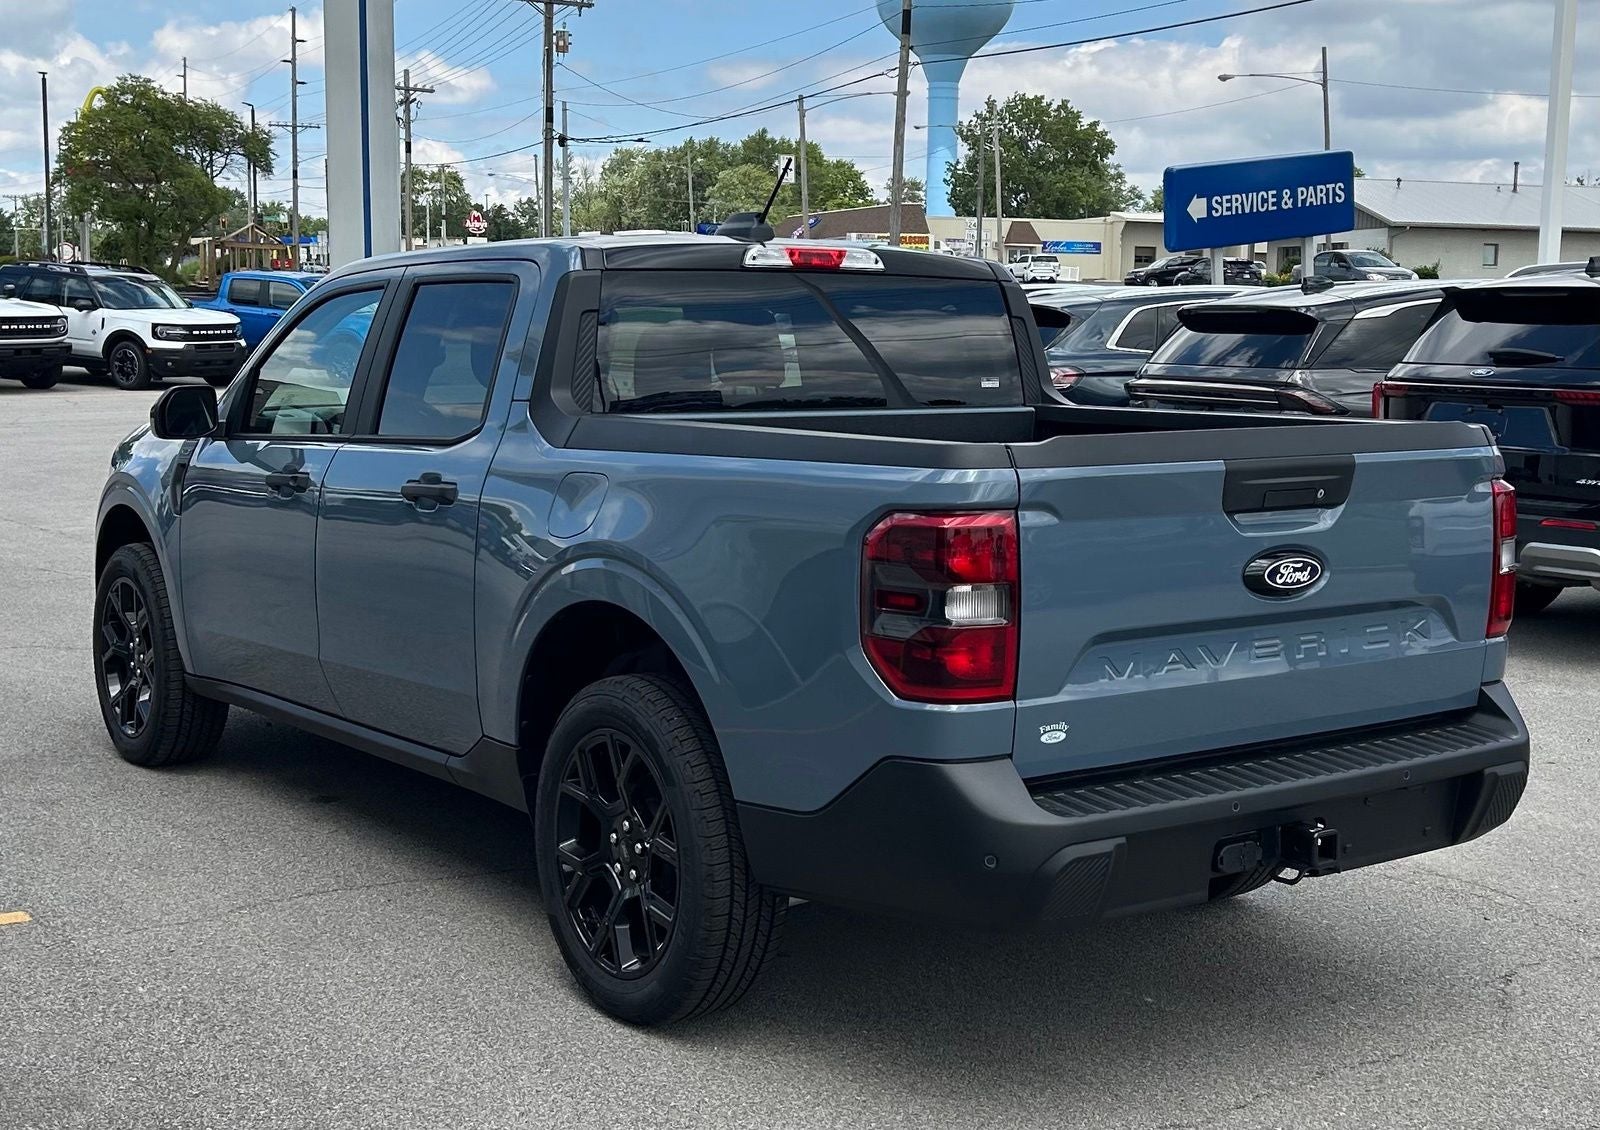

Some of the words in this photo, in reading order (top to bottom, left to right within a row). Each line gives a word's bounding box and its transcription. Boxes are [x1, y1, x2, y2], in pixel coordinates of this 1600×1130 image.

[1211, 189, 1278, 218] SERVICE
[1281, 188, 1294, 210] &
[1297, 182, 1346, 208] PARTS
[1275, 561, 1312, 585] Ford
[1098, 617, 1433, 682] MAVERICK
[1039, 721, 1070, 734] Family
